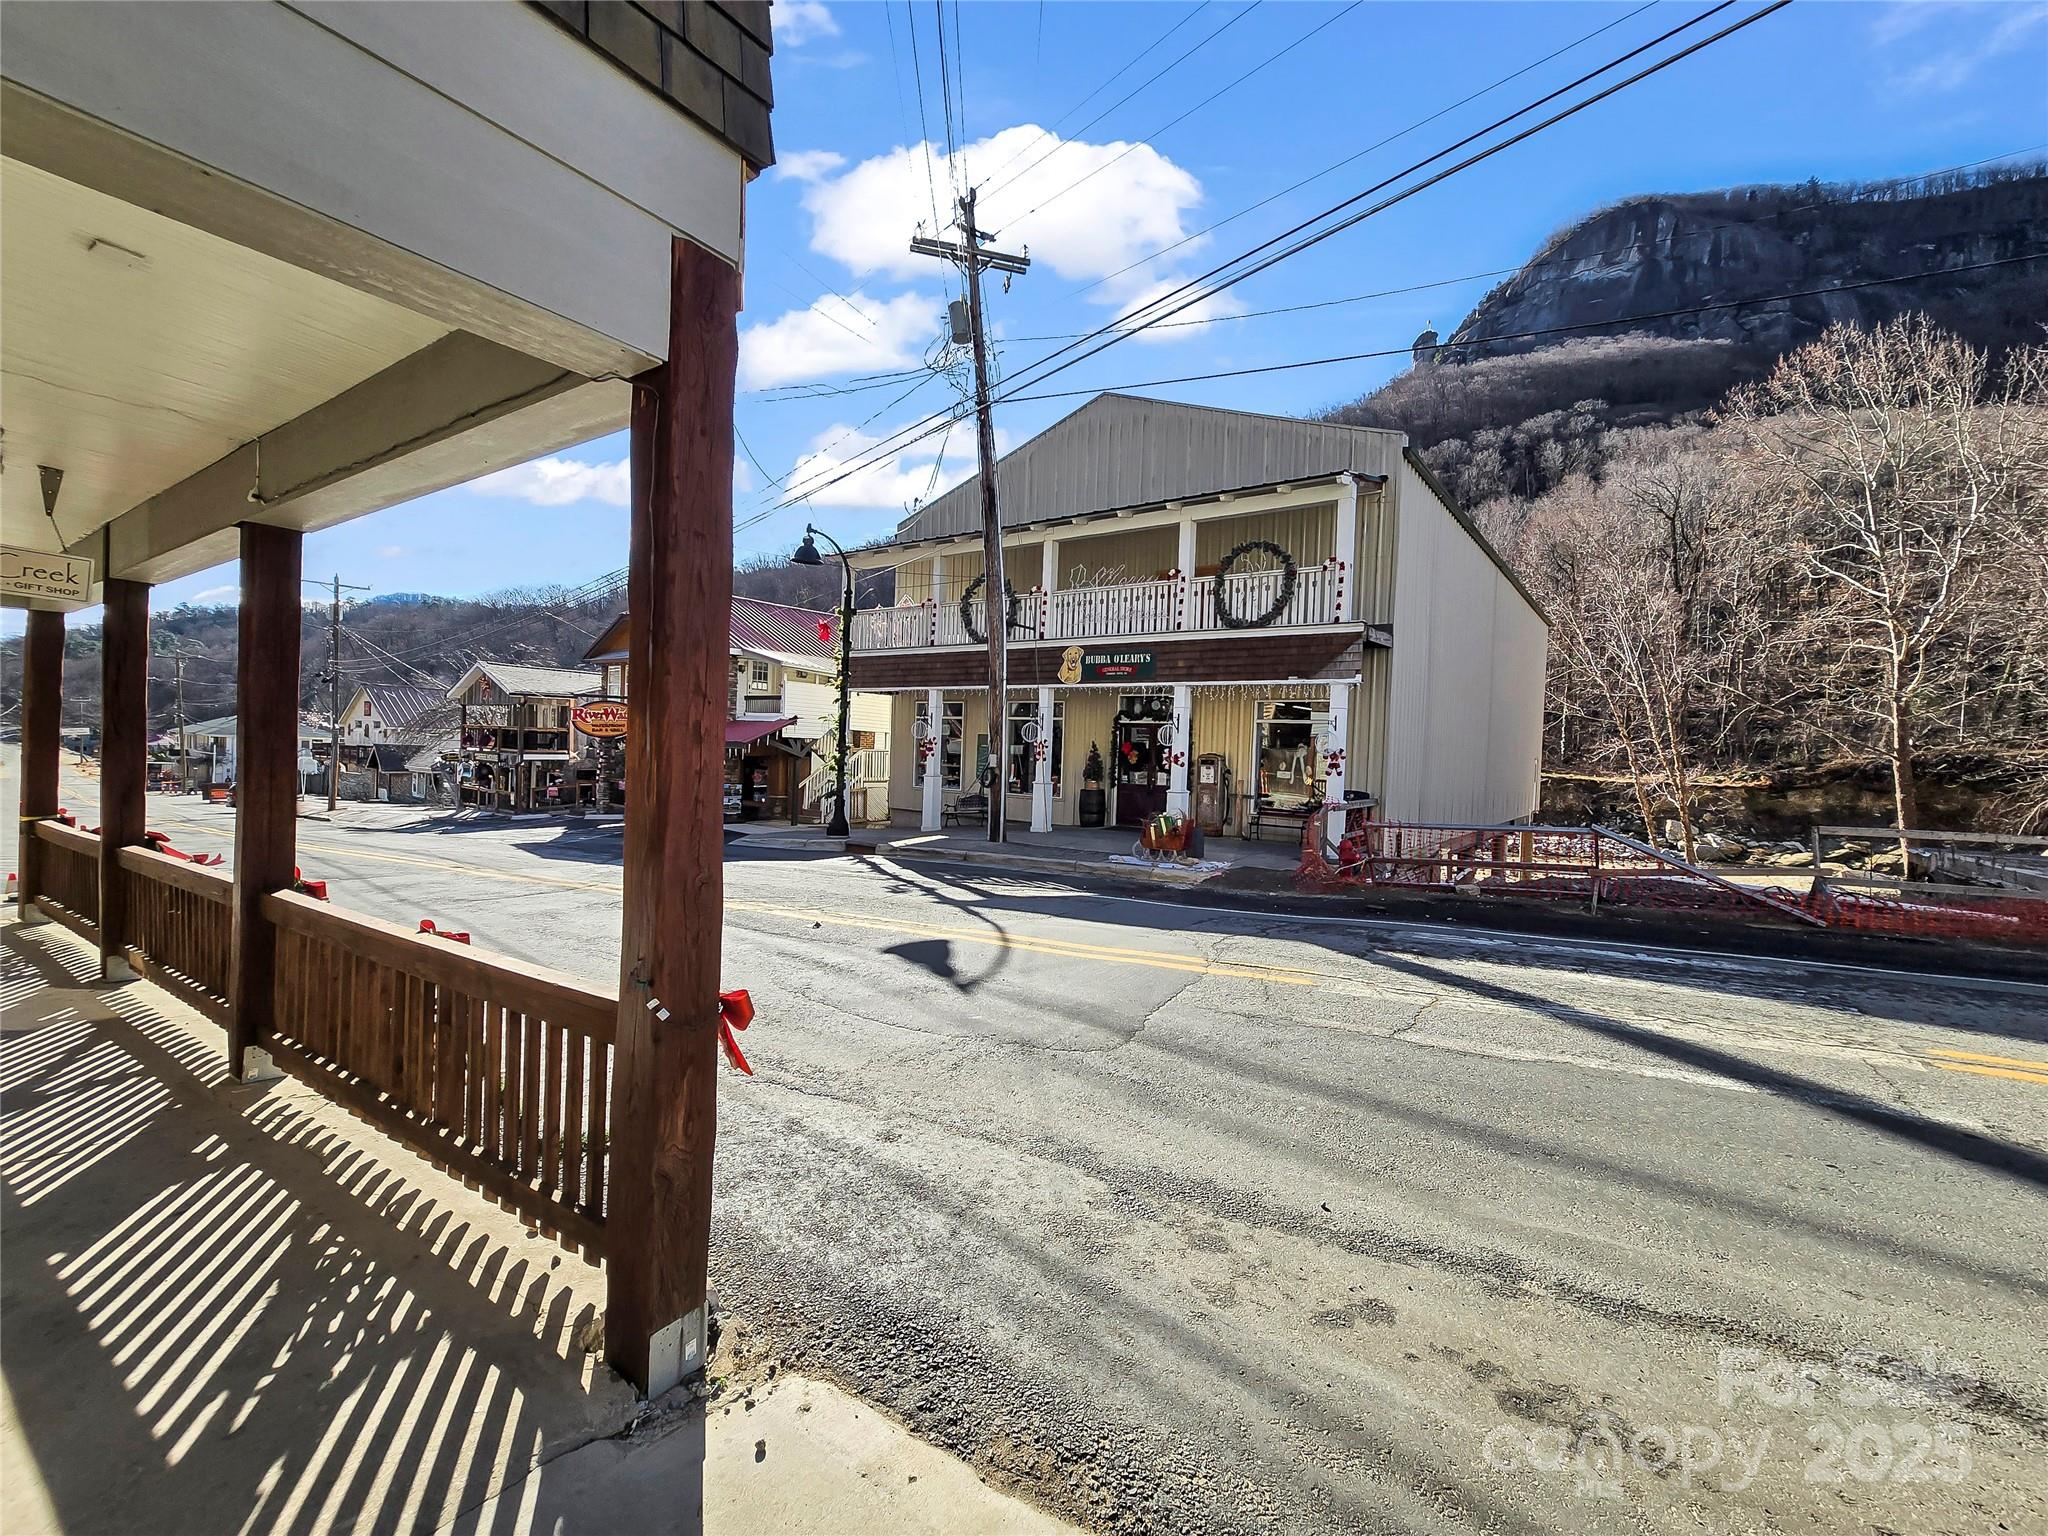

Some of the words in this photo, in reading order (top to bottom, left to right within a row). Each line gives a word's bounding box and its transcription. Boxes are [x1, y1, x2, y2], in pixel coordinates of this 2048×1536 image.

[14, 581, 44, 592] GIFT
[46, 585, 80, 597] SHOP
[1085, 655, 1111, 665] BUBBA
